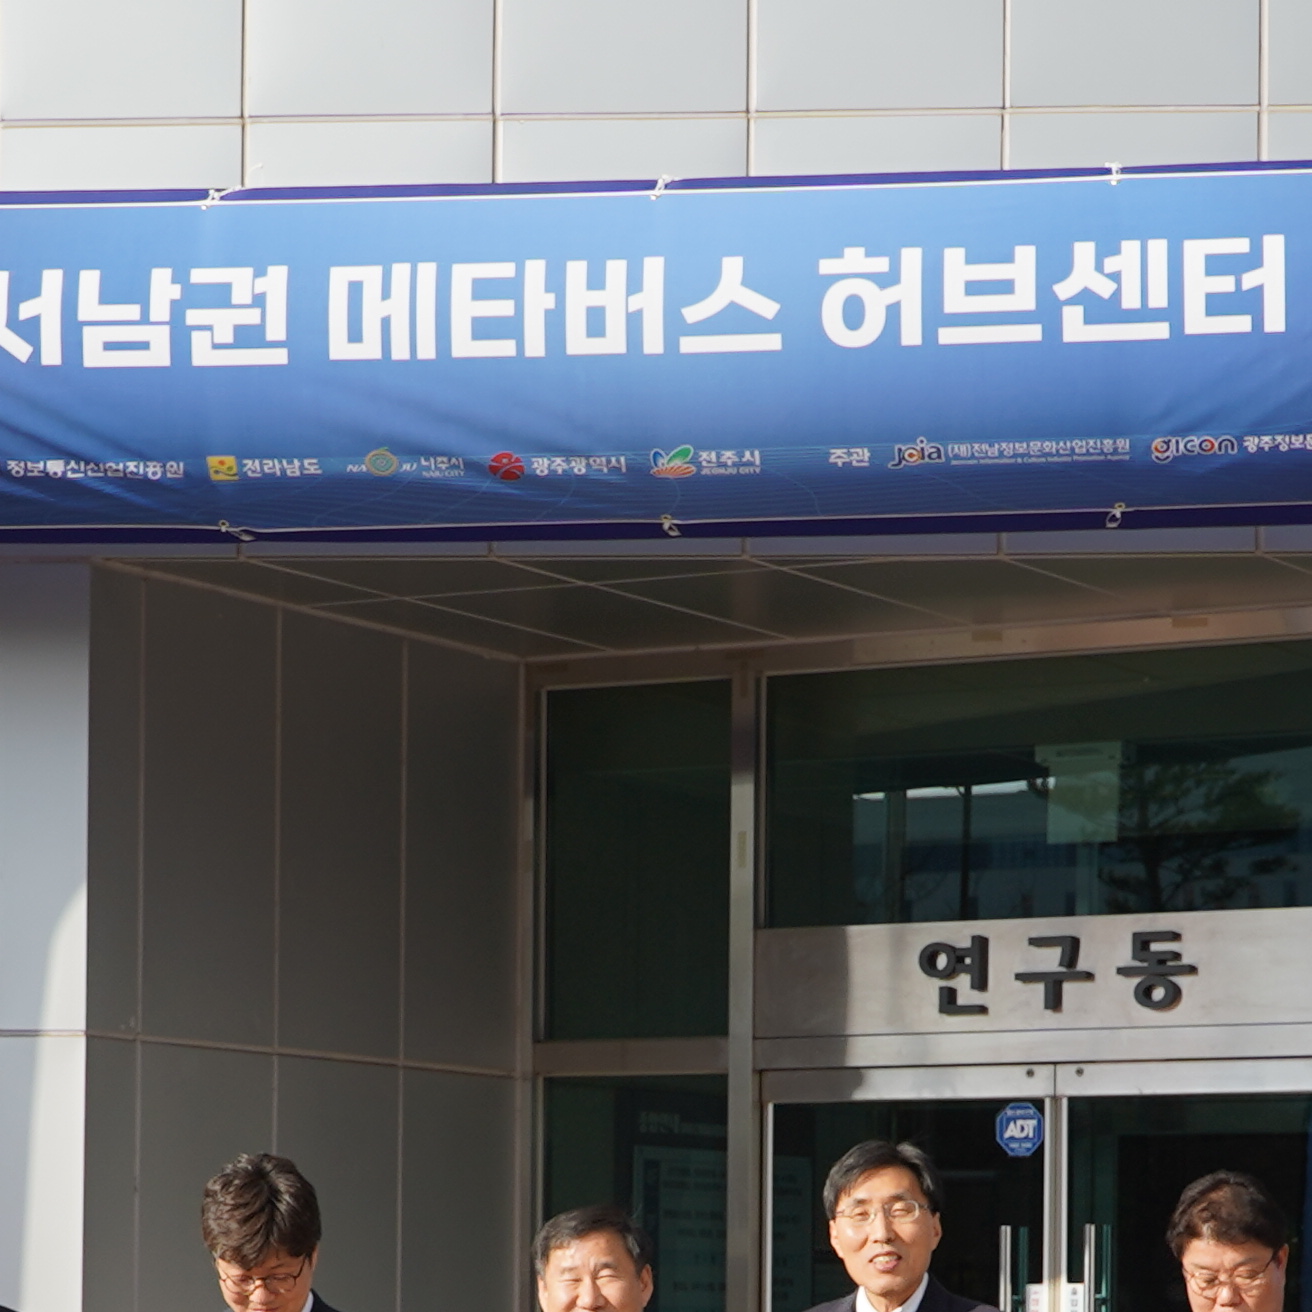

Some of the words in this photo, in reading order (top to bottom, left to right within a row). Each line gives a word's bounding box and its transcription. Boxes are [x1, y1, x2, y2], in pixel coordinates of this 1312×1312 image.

[327, 255, 783, 361] 메타버스
[818, 234, 1286, 348] 허브센터
[697, 449, 761, 467] 전주시
[828, 447, 870, 467] 주관
[948, 438, 1130, 458] (재)전남정보문화산업진흥원
[1152, 436, 1238, 463] gicon
[6, 459, 184, 480] 정보통신산업진흥원
[242, 458, 322, 477] 전라남도
[530, 456, 627, 476] 광주광역시
[919, 929, 1199, 1016] 연구동
[1003, 1118, 1038, 1139] ADT
